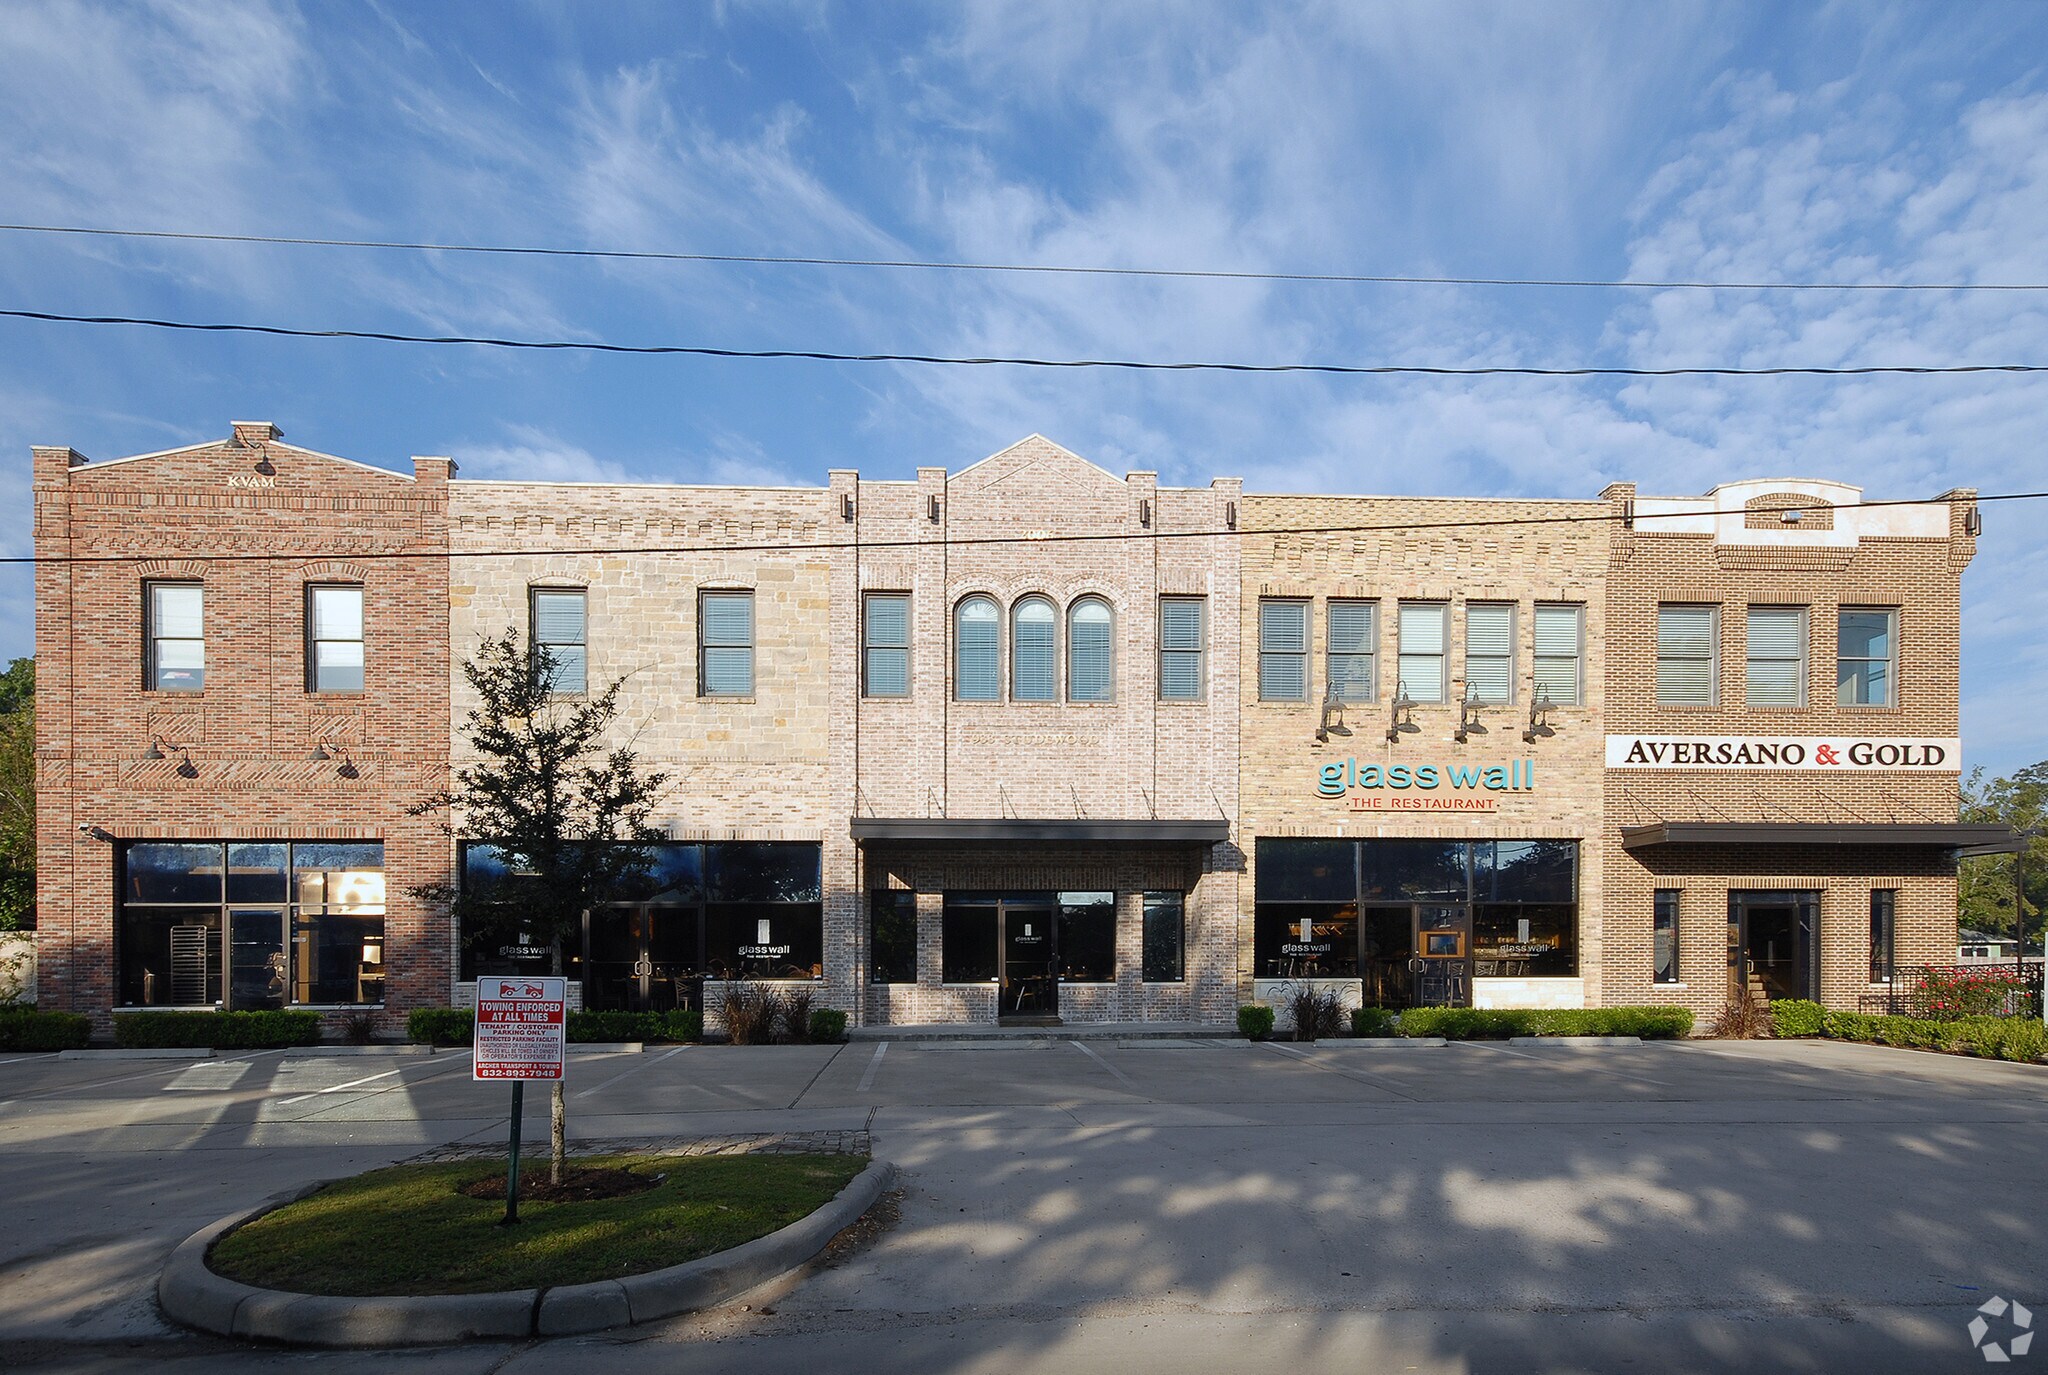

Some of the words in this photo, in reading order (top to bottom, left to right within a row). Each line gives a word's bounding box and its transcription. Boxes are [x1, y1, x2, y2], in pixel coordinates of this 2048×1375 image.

[227, 476, 276, 488] KVAM
[1624, 739, 1805, 766] AVERSANO
[1815, 744, 1841, 766] &
[1849, 742, 1946, 767] GOLD
[1317, 756, 1440, 795] glass
[1446, 758, 1534, 791] wall
[1351, 797, 1382, 808] THE
[1391, 798, 1494, 810] RESTAURANT
[499, 945, 529, 956] glass
[530, 945, 552, 954] wall
[738, 945, 768, 956] glass
[768, 945, 790, 954] wall
[1281, 943, 1310, 954] glass
[1310, 943, 1331, 951] wall
[1500, 944, 1527, 954] glass
[1528, 944, 1548, 952] wall
[481, 1002, 514, 1011] TOWING
[516, 1003, 560, 1012] ENFORCED
[492, 1012, 504, 1021] AT
[504, 1012, 521, 1021] ALL
[522, 1013, 549, 1022] TIMES
